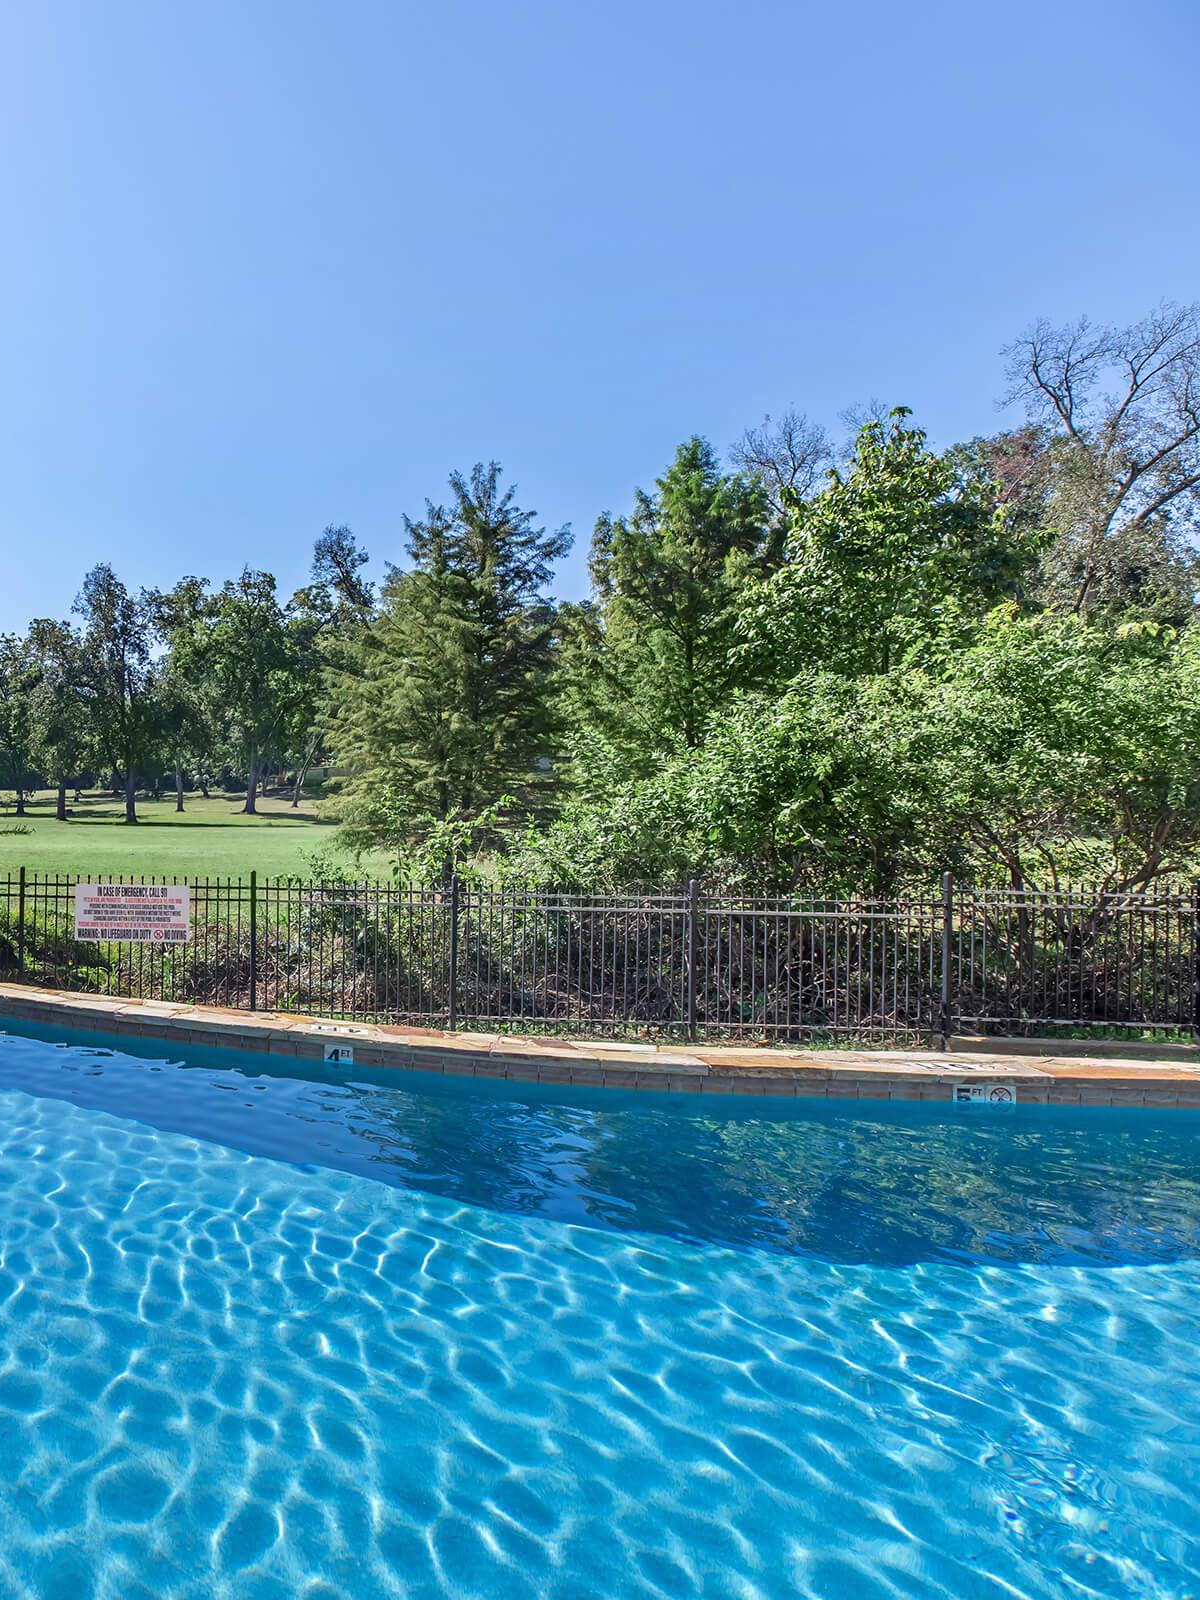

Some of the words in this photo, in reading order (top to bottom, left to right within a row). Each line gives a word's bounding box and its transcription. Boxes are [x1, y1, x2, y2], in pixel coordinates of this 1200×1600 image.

[97, 886, 102, 897] IN
[103, 886, 115, 897] CASE
[115, 887, 121, 897] OF
[149, 887, 160, 897] CALL
[77, 928, 100, 939] WARNING:
[101, 928, 107, 939] NO
[107, 928, 132, 939] LIFEGUARD
[132, 929, 139, 940] ON
[139, 929, 152, 940] DUTY
[164, 930, 171, 940] NO
[171, 930, 187, 940] DIVING
[972, 1088, 982, 1096] FT
